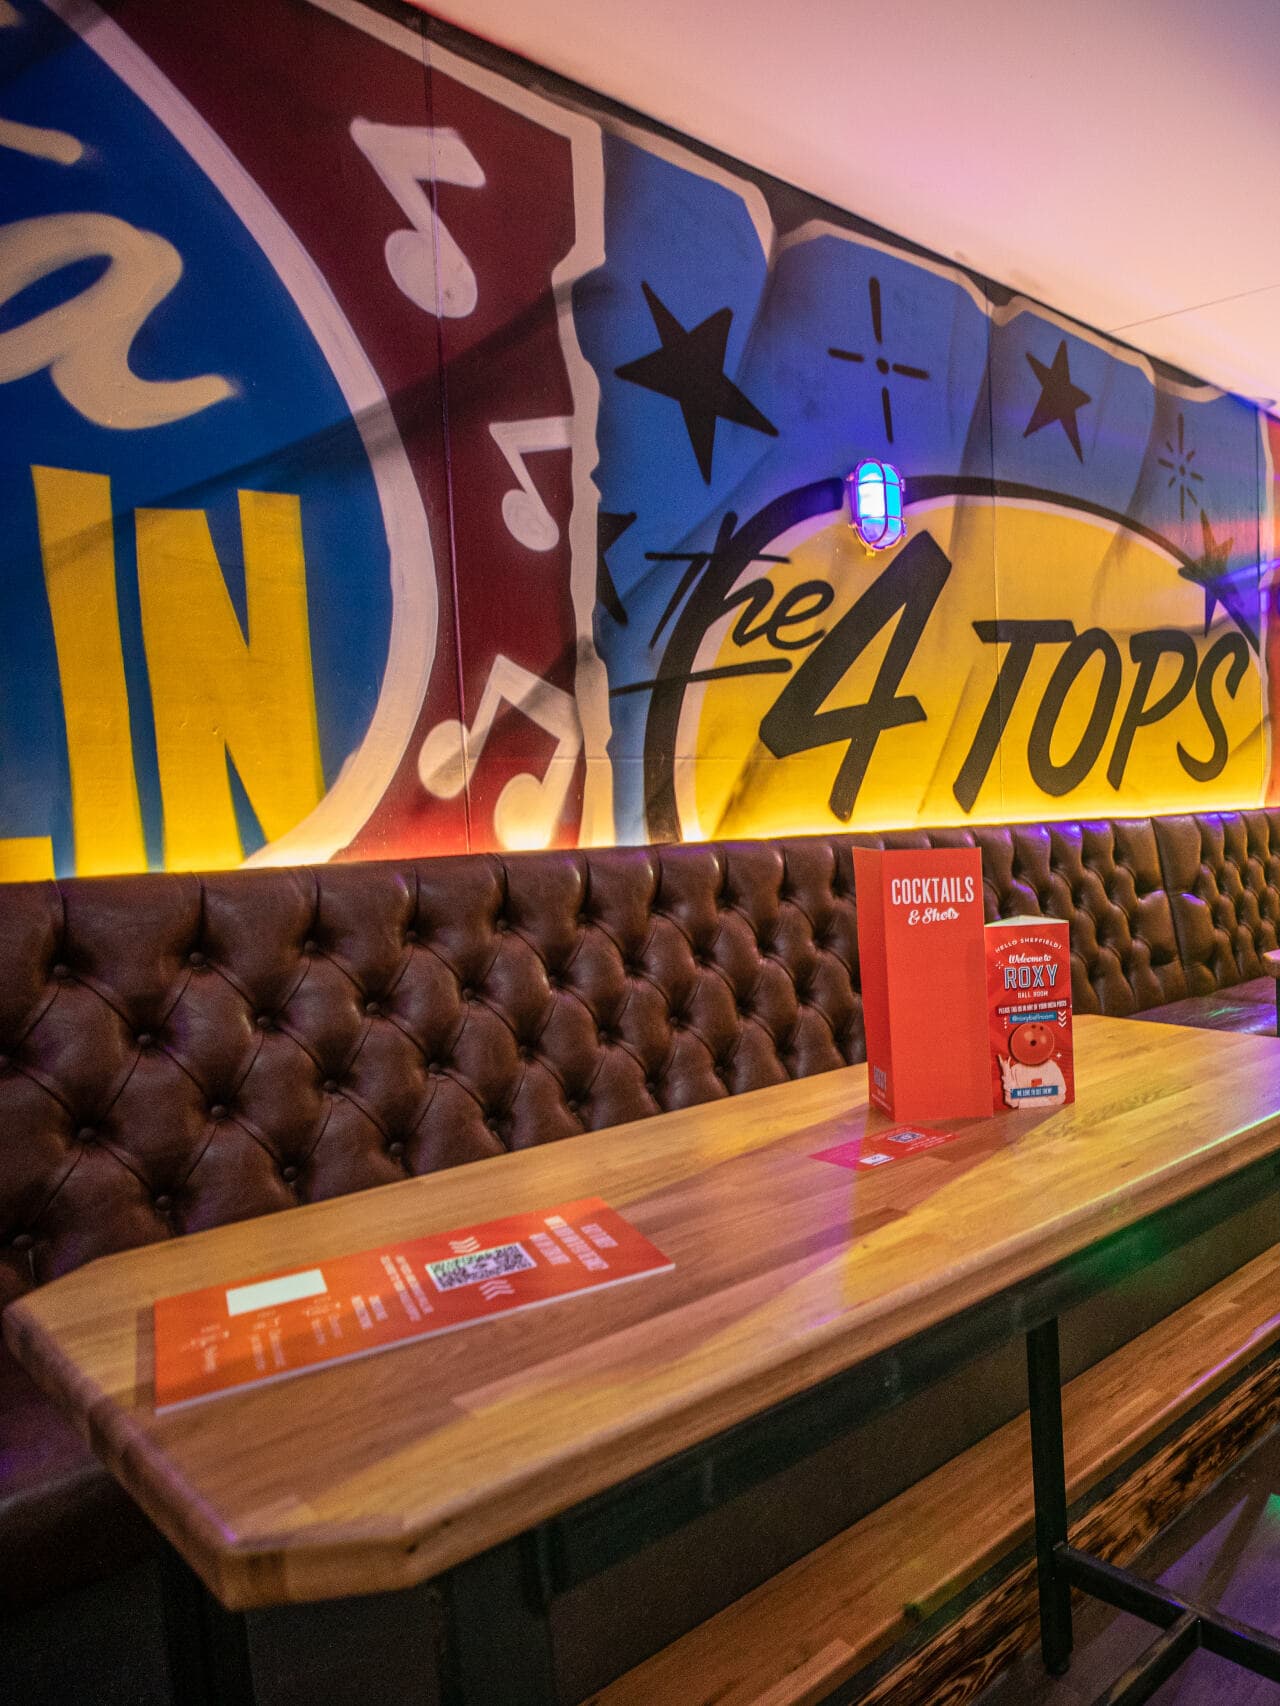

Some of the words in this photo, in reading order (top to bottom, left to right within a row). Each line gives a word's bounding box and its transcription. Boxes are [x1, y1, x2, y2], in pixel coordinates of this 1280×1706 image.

[758, 530, 952, 822] 4
[952, 620, 1249, 815] TOPS
[891, 876, 974, 905] COCKTAILS
[908, 909, 920, 926] &
[921, 907, 960, 925] Shots
[994, 939, 1018, 953] HELLO
[1008, 952, 1043, 964] Welcome
[1004, 963, 1058, 990] ROXY
